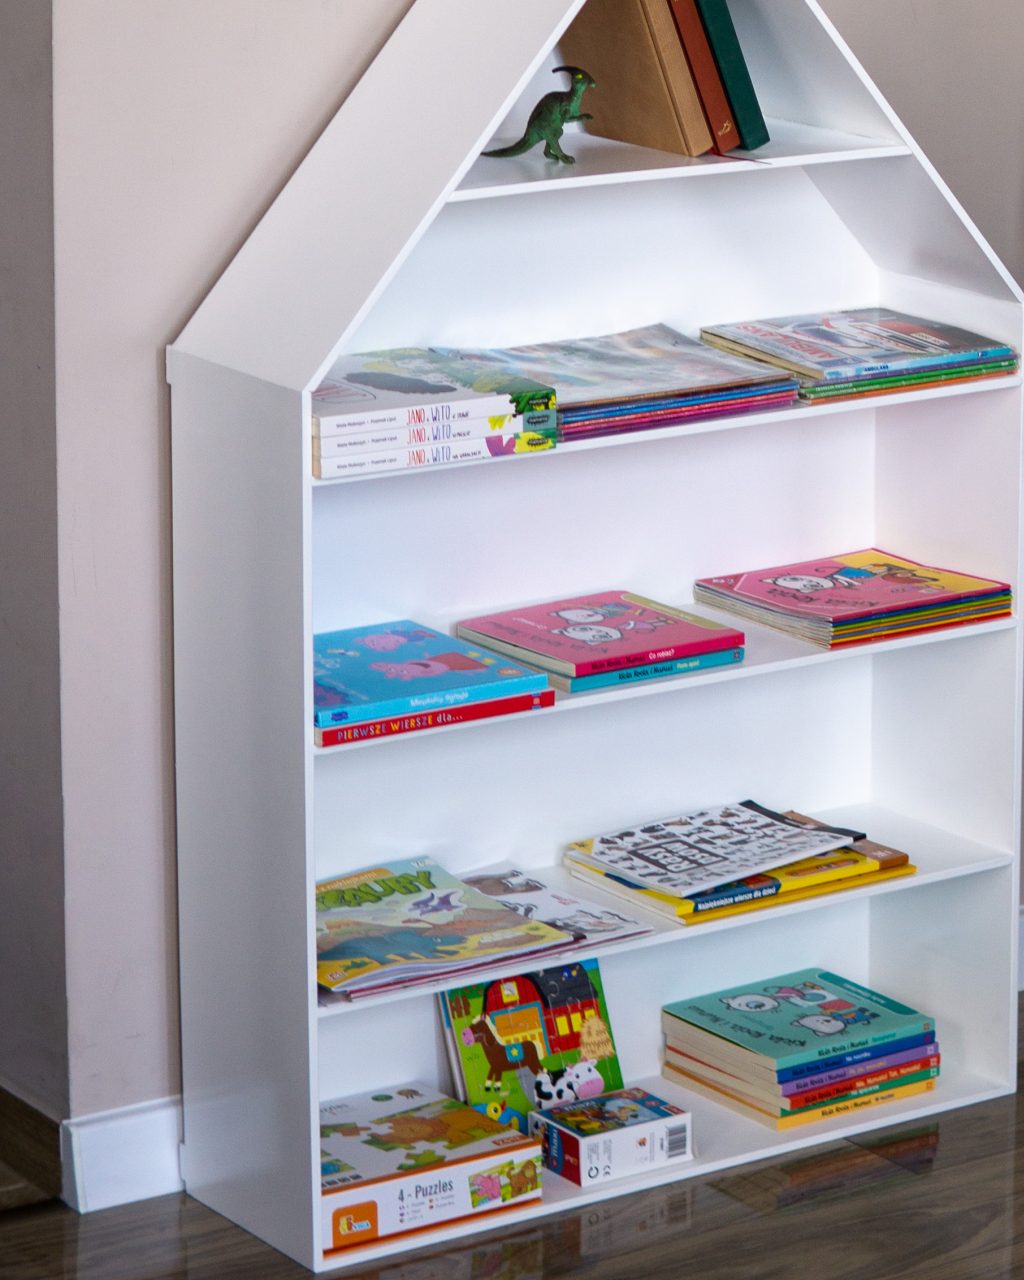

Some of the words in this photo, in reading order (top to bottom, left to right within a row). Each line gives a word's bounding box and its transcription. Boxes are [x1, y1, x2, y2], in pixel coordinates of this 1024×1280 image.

[406, 407, 426, 426] JANO
[430, 404, 451, 423] WITO
[406, 426, 426, 445] JANO
[431, 423, 452, 441] WITO
[406, 448, 426, 466] JANO
[430, 445, 451, 463] WITO
[337, 724, 387, 740] PIERWSZE
[390, 715, 433, 732] WIERSZE
[636, 847, 699, 872] Rasy
[398, 1188, 404, 1202] 4
[415, 1178, 454, 1199] Puzzles
